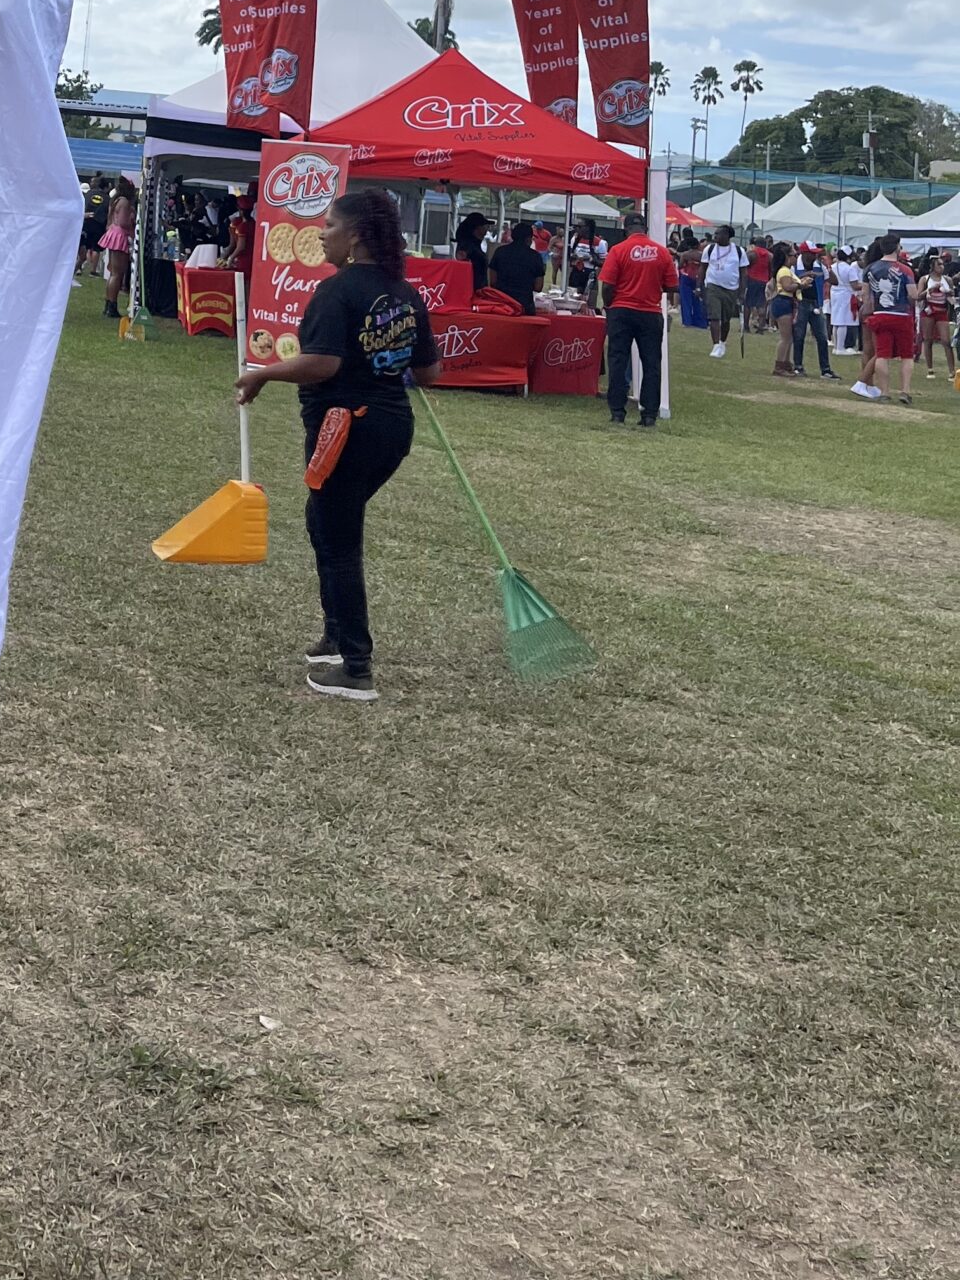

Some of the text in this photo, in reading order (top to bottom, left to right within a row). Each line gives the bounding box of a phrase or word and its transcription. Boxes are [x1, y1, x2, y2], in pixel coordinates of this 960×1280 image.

[251, 2, 307, 19] Supplies
[525, 6, 562, 20] Years
[539, 23, 553, 35] of
[590, 12, 629, 29] Vital
[224, 39, 256, 54] Suppl
[533, 40, 564, 54] Vital
[583, 32, 648, 51] Supplies
[524, 56, 580, 73] Supplies
[229, 84, 261, 113] Cri
[597, 83, 650, 122] Crix
[404, 96, 525, 130] Crix
[455, 130, 535, 143] Vital Supplies
[350, 144, 376, 161] rix
[413, 148, 453, 166] Crix
[493, 155, 533, 173] Crix
[571, 162, 611, 181] Crix
[264, 163, 339, 206] Crix
[630, 245, 658, 261] Crix
[271, 265, 321, 300] Years
[418, 283, 446, 311] ix
[252, 308, 278, 322] Vital
[285, 302, 299, 313] of
[433, 325, 484, 358] rix
[543, 337, 596, 366] Crix
